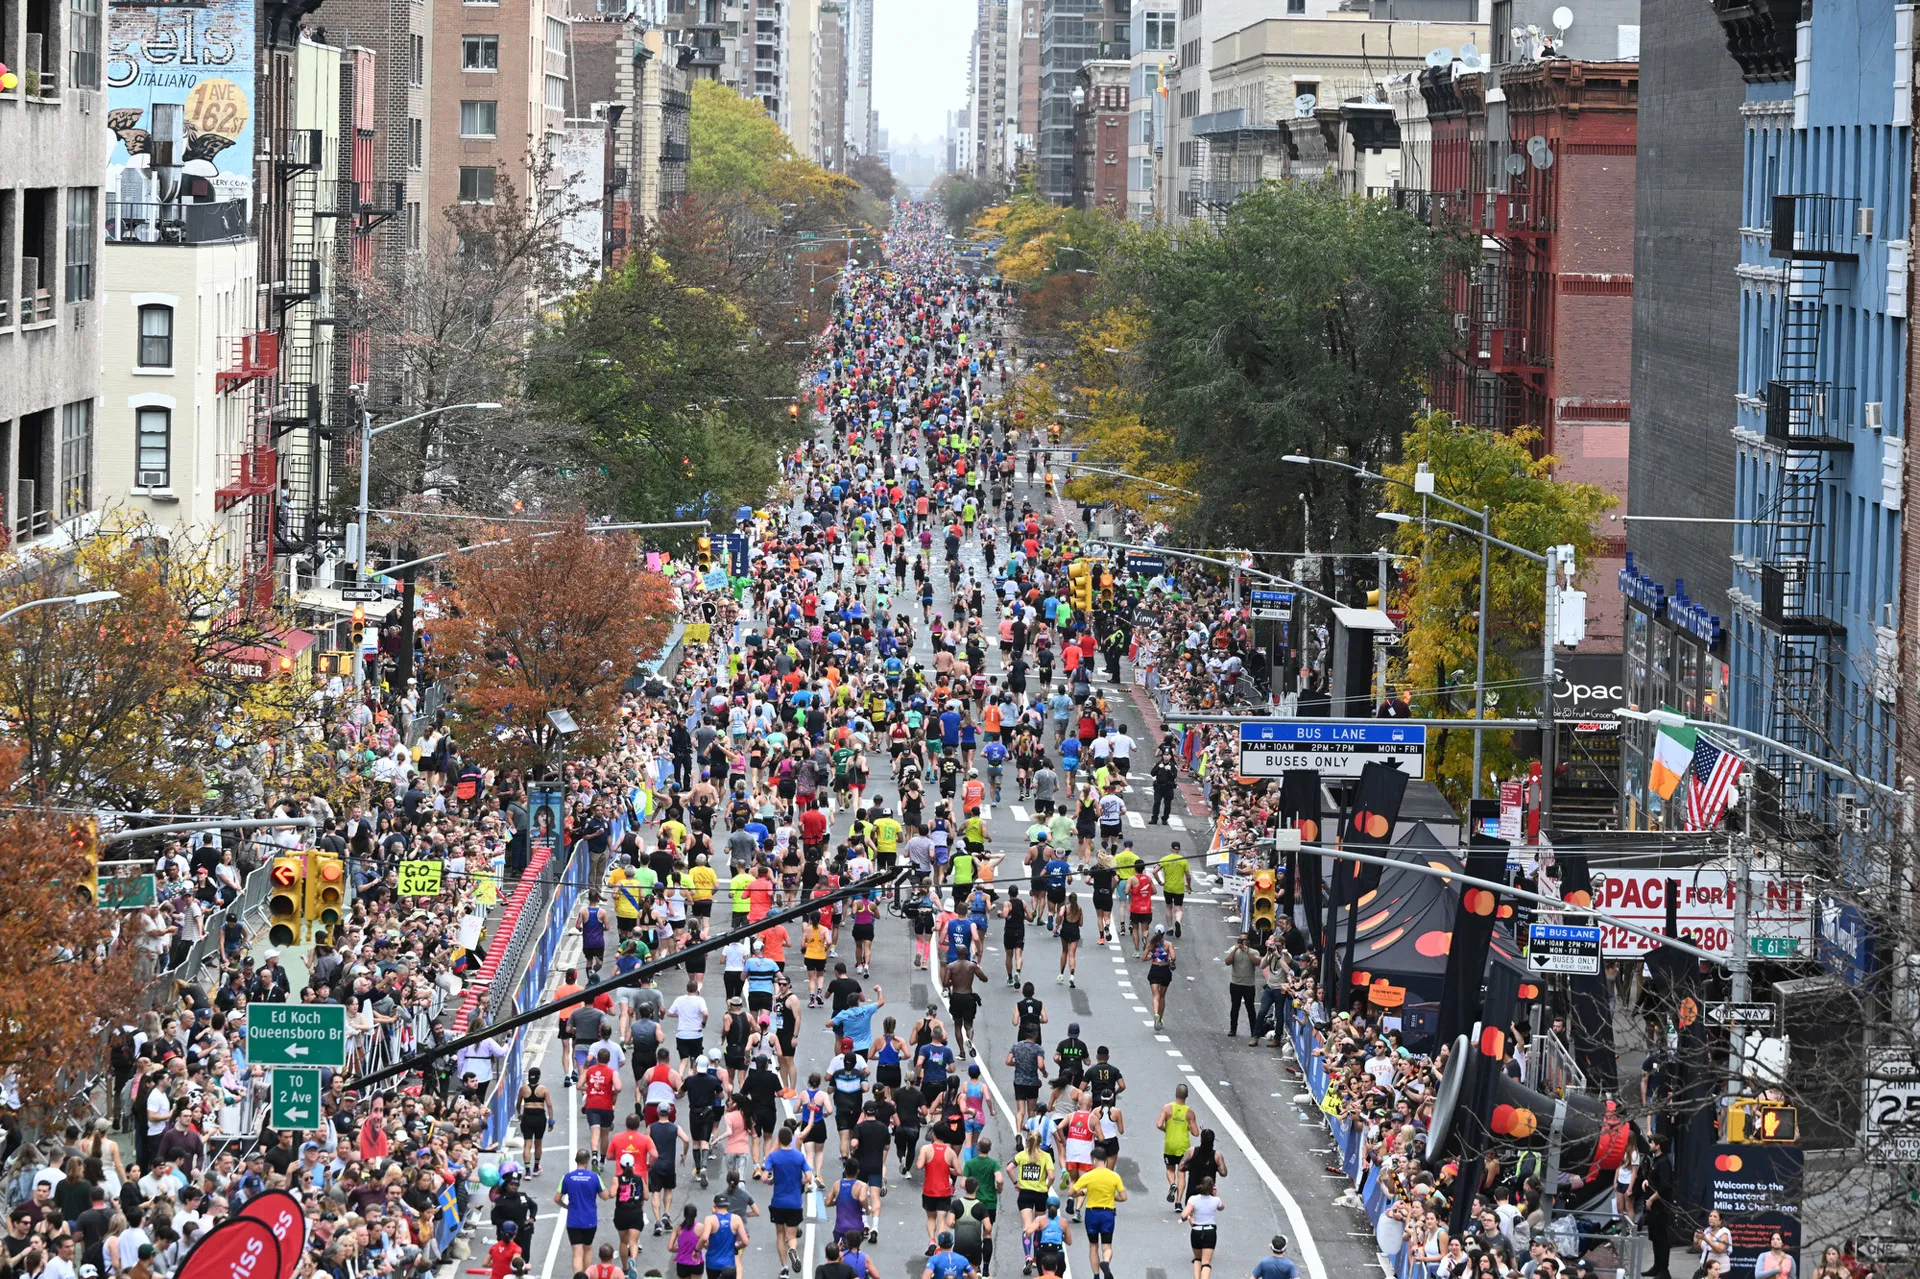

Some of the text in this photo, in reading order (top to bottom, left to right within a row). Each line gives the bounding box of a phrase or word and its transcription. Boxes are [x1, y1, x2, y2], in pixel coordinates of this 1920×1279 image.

[137, 73, 197, 88] ITALIANO
[209, 84, 236, 101] AVE
[1133, 610, 1156, 627] Vinny
[231, 663, 263, 677] DINER
[1591, 708, 1616, 720] Grocery
[1297, 728, 1366, 740] BUS LANE
[1266, 756, 1349, 767] BUSES ONLY
[405, 865, 429, 878] GO
[402, 880, 438, 893] SUZ
[1686, 887, 1722, 904] FOR
[1570, 930, 1594, 938] LANE
[1758, 941, 1763, 953] E
[1768, 940, 1778, 953] 61
[271, 1011, 321, 1024] Ed Koch
[1716, 1010, 1766, 1019] ONE WAY
[250, 1026, 342, 1040] Queensboro Br
[1064, 1047, 1082, 1056] MARC
[1099, 1070, 1109, 1080] 13
[1372, 1065, 1390, 1073] TEXAS
[289, 1075, 303, 1087] TO
[1886, 1081, 1916, 1090] LIMIT
[280, 1090, 312, 1103] 2 Ave
[1070, 1126, 1087, 1136] ITALIA
[1883, 1140, 1920, 1148] PHOTO
[1714, 1181, 1784, 1191] Welcome to the
[1714, 1191, 1766, 1200] Mastercard
[1714, 1202, 1733, 1210] Mile
